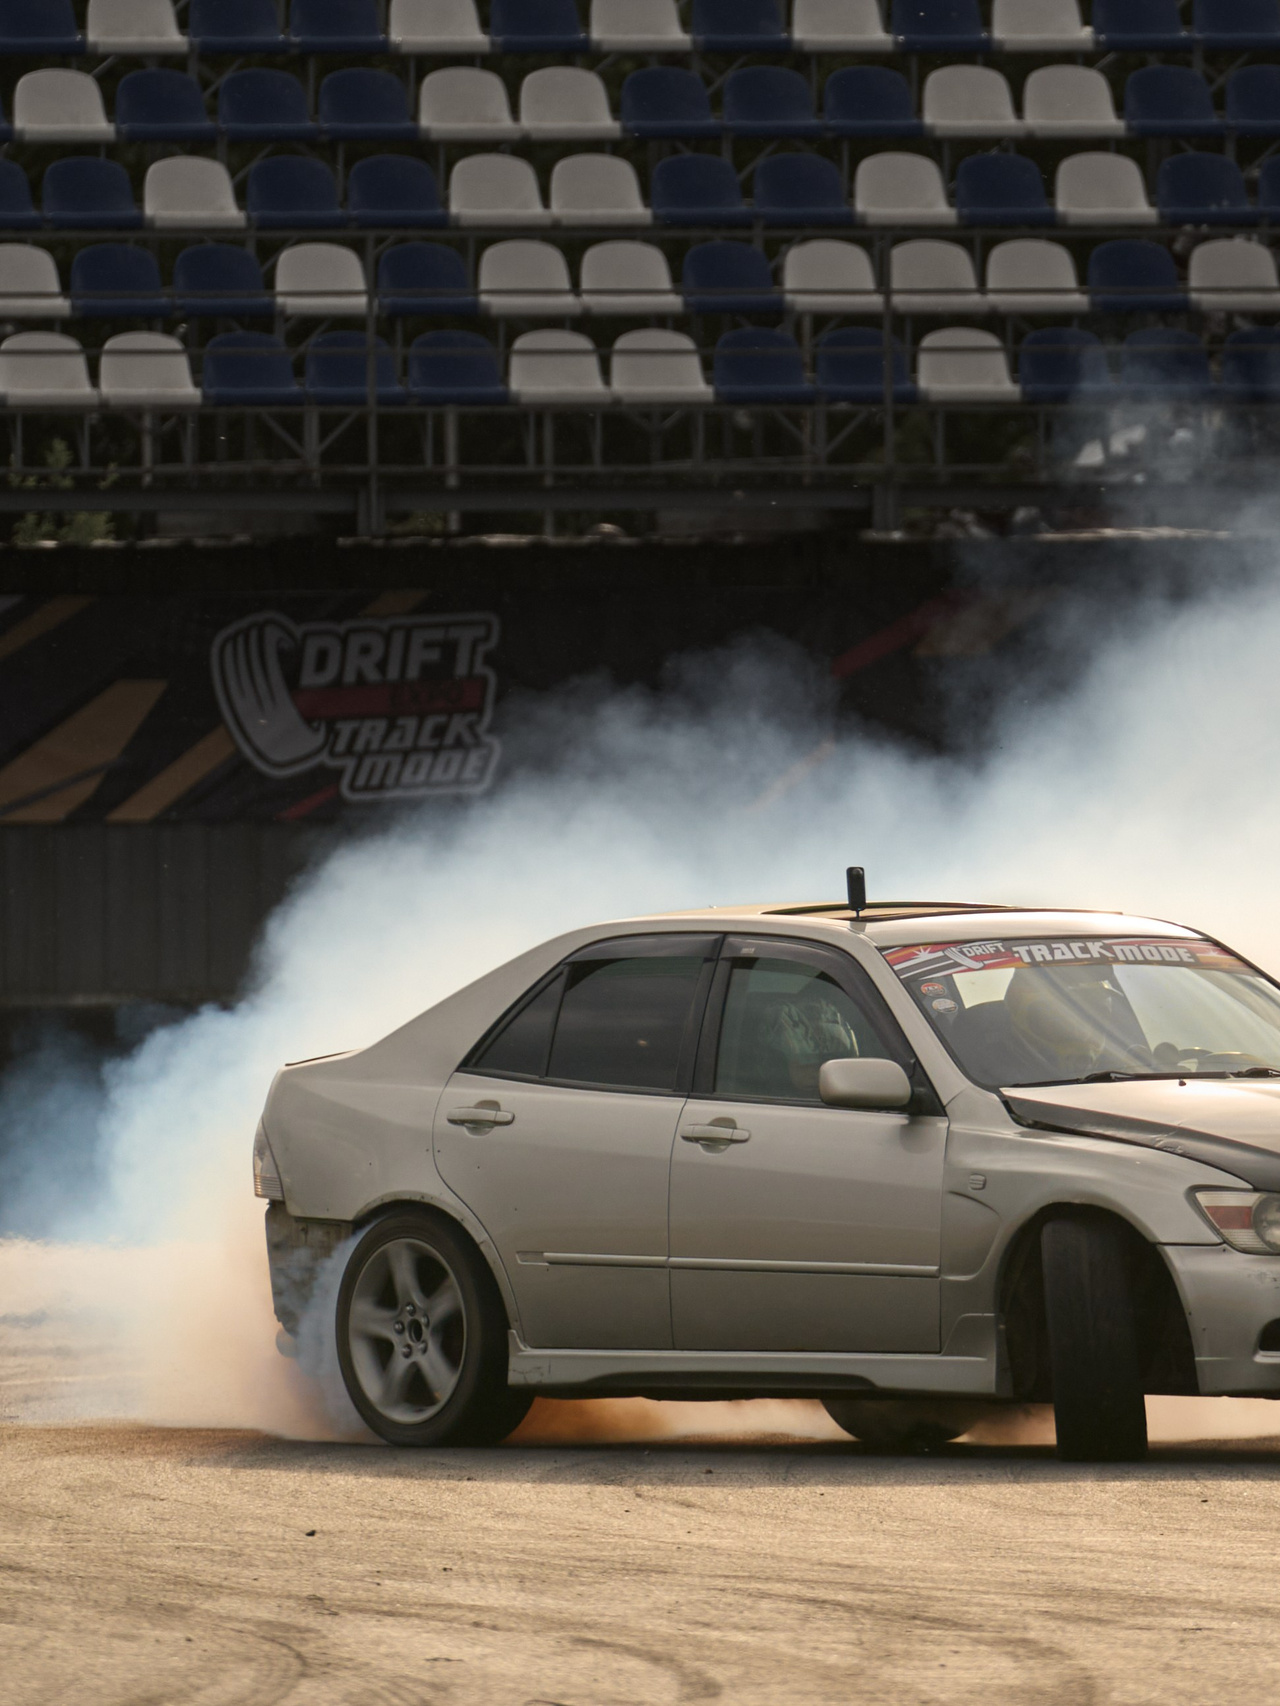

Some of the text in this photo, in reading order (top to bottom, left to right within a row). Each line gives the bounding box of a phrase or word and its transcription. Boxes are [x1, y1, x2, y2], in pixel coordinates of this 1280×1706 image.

[301, 626, 486, 687] DRIFT
[332, 712, 478, 752] TRACK
[354, 752, 484, 788] MODE
[961, 941, 1195, 963] DRIFT TRACK MODE
